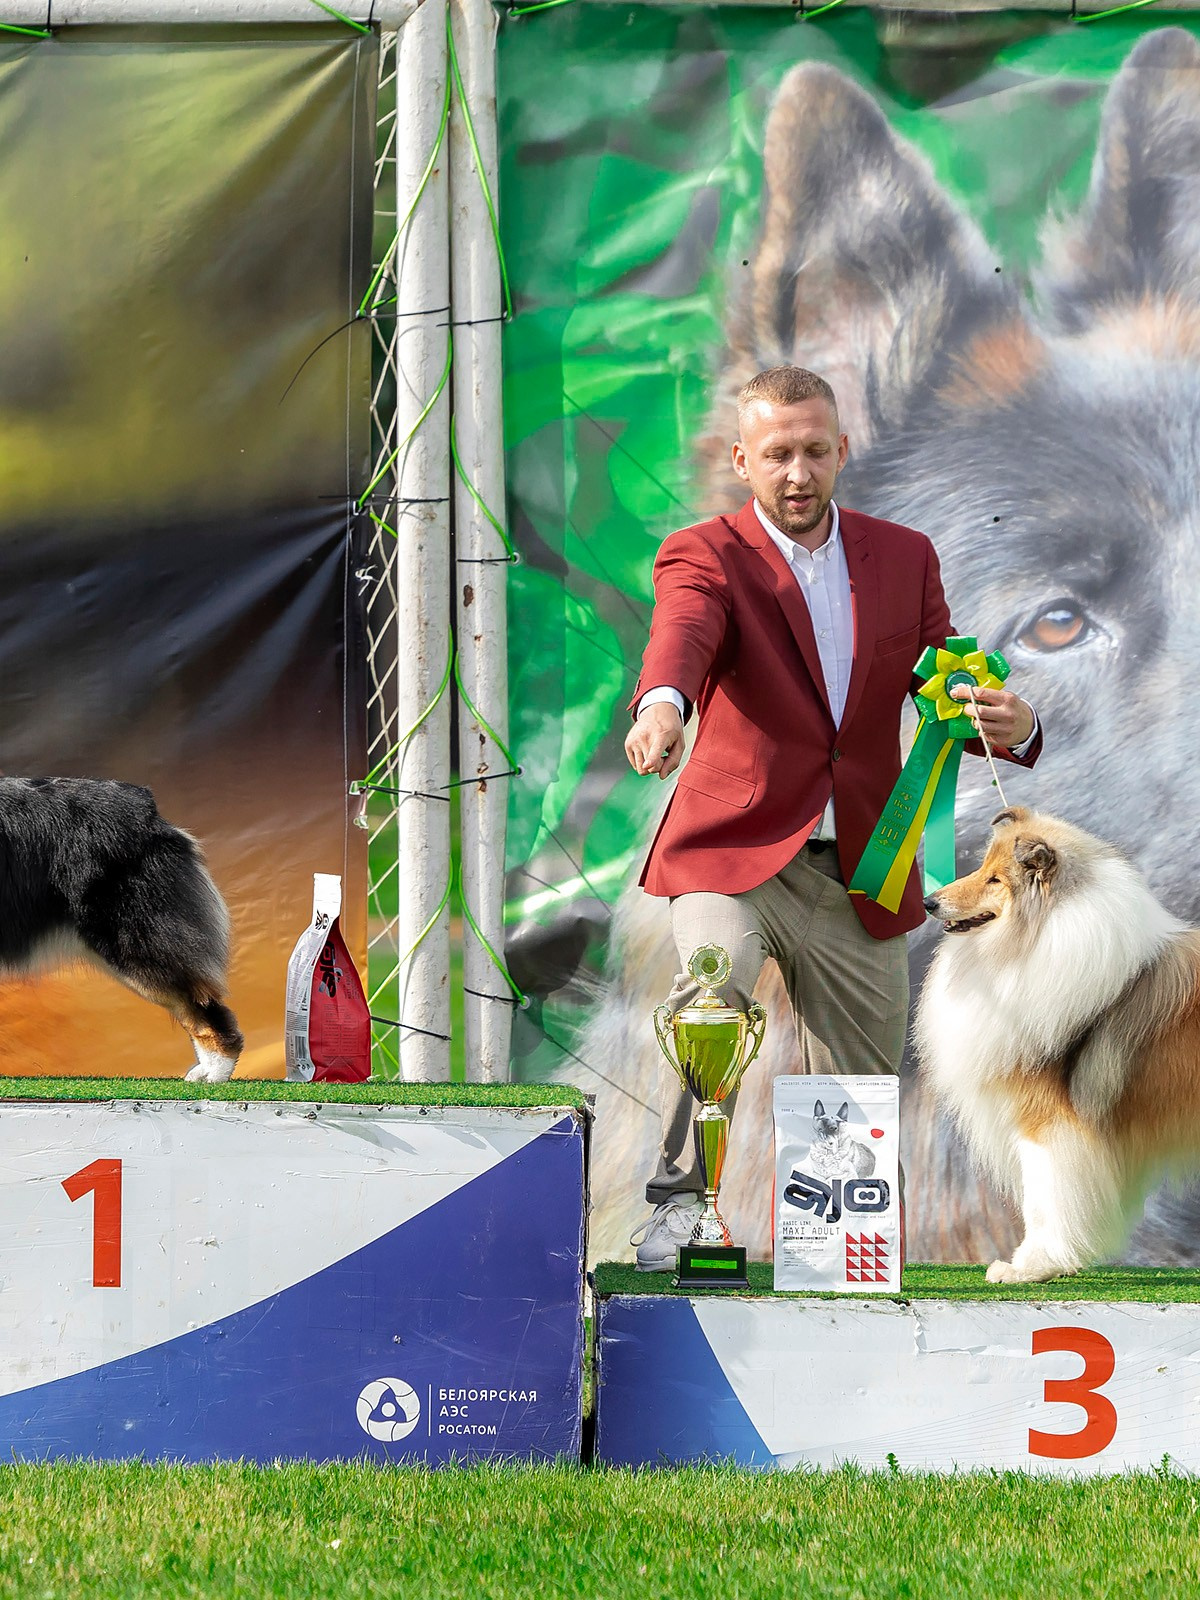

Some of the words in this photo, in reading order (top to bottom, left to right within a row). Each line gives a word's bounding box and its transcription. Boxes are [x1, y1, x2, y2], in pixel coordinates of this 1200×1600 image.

[63, 1159, 121, 1287] 1
[782, 1227, 805, 1236] MAXI
[812, 1227, 840, 1236] ADULT
[439, 1389, 537, 1402] БЕЛОЯРСКАЯ
[1028, 1327, 1117, 1459] 3
[439, 1405, 469, 1418] АЭС
[438, 1424, 497, 1435] РОСАТОМ
